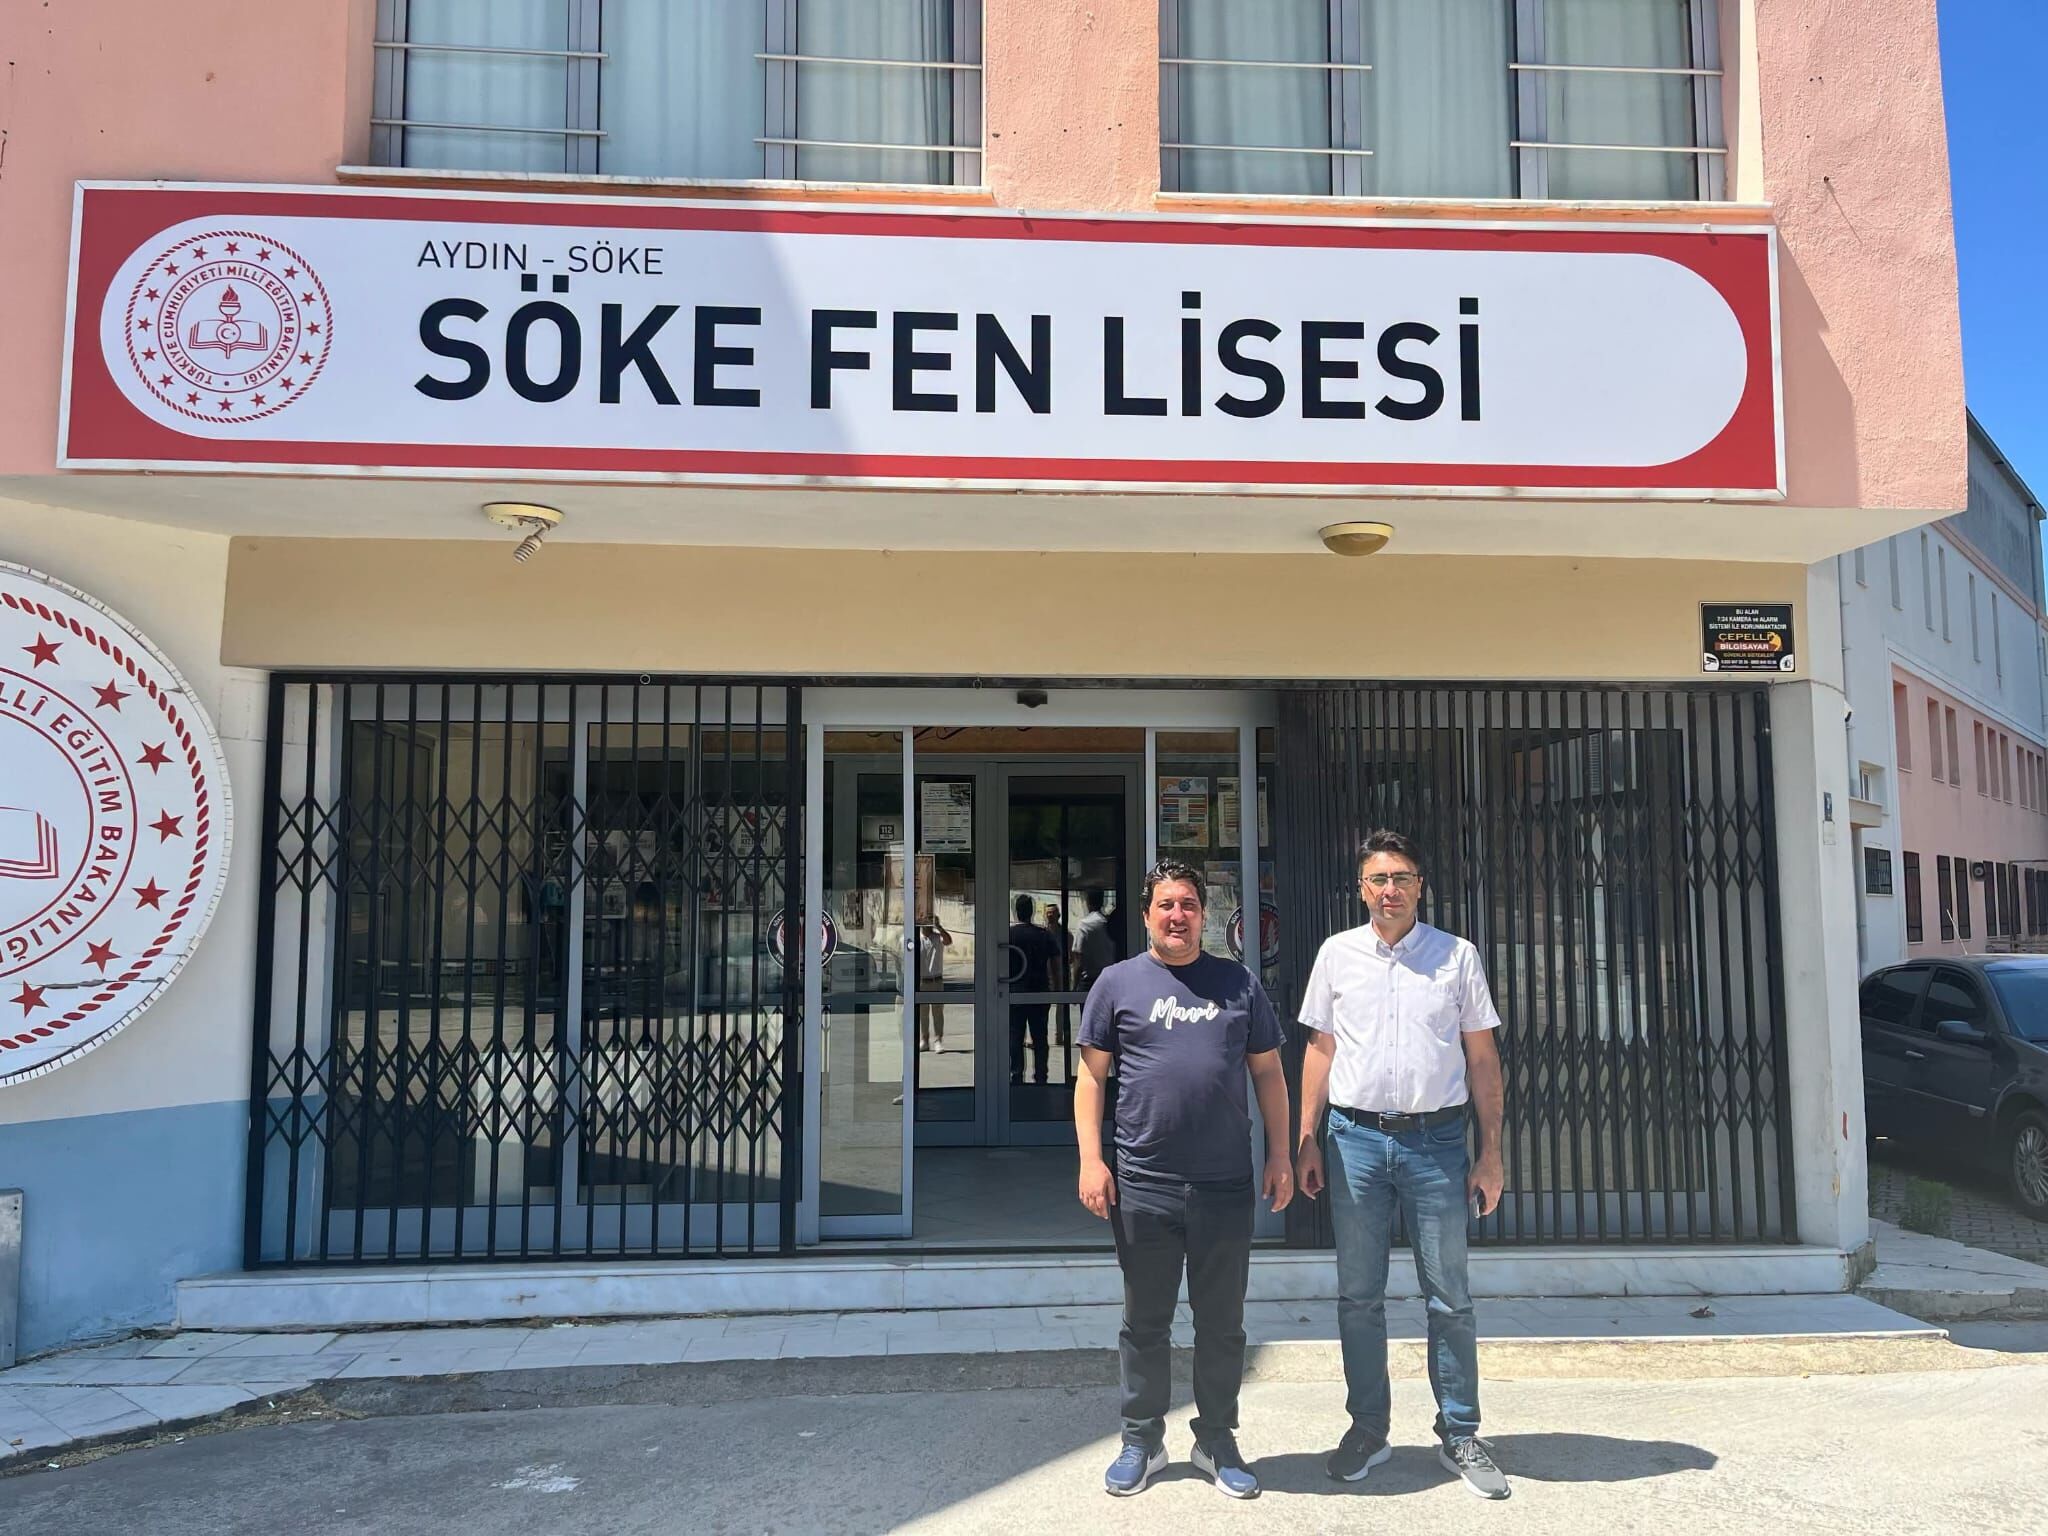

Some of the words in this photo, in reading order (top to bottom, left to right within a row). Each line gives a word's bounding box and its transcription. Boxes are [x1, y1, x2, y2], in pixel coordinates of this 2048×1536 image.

[417, 240, 528, 270] AYDIN
[568, 243, 664, 275] SÖKE
[163, 265, 222, 338] CUMHURİYETİ
[264, 280, 295, 322] EĞİTİM
[166, 343, 213, 385] TÜRKİYE
[244, 326, 295, 386] BAKANLIĞI
[415, 273, 762, 408] SÖKE
[810, 309, 1051, 414] FEN
[1103, 291, 1481, 422] LİSESİ
[49, 713, 123, 812] EĞİTİM
[880, 826, 893, 834] 112
[0, 826, 123, 963] BAKANLIĞ
[1149, 995, 1219, 1030] Mavi
